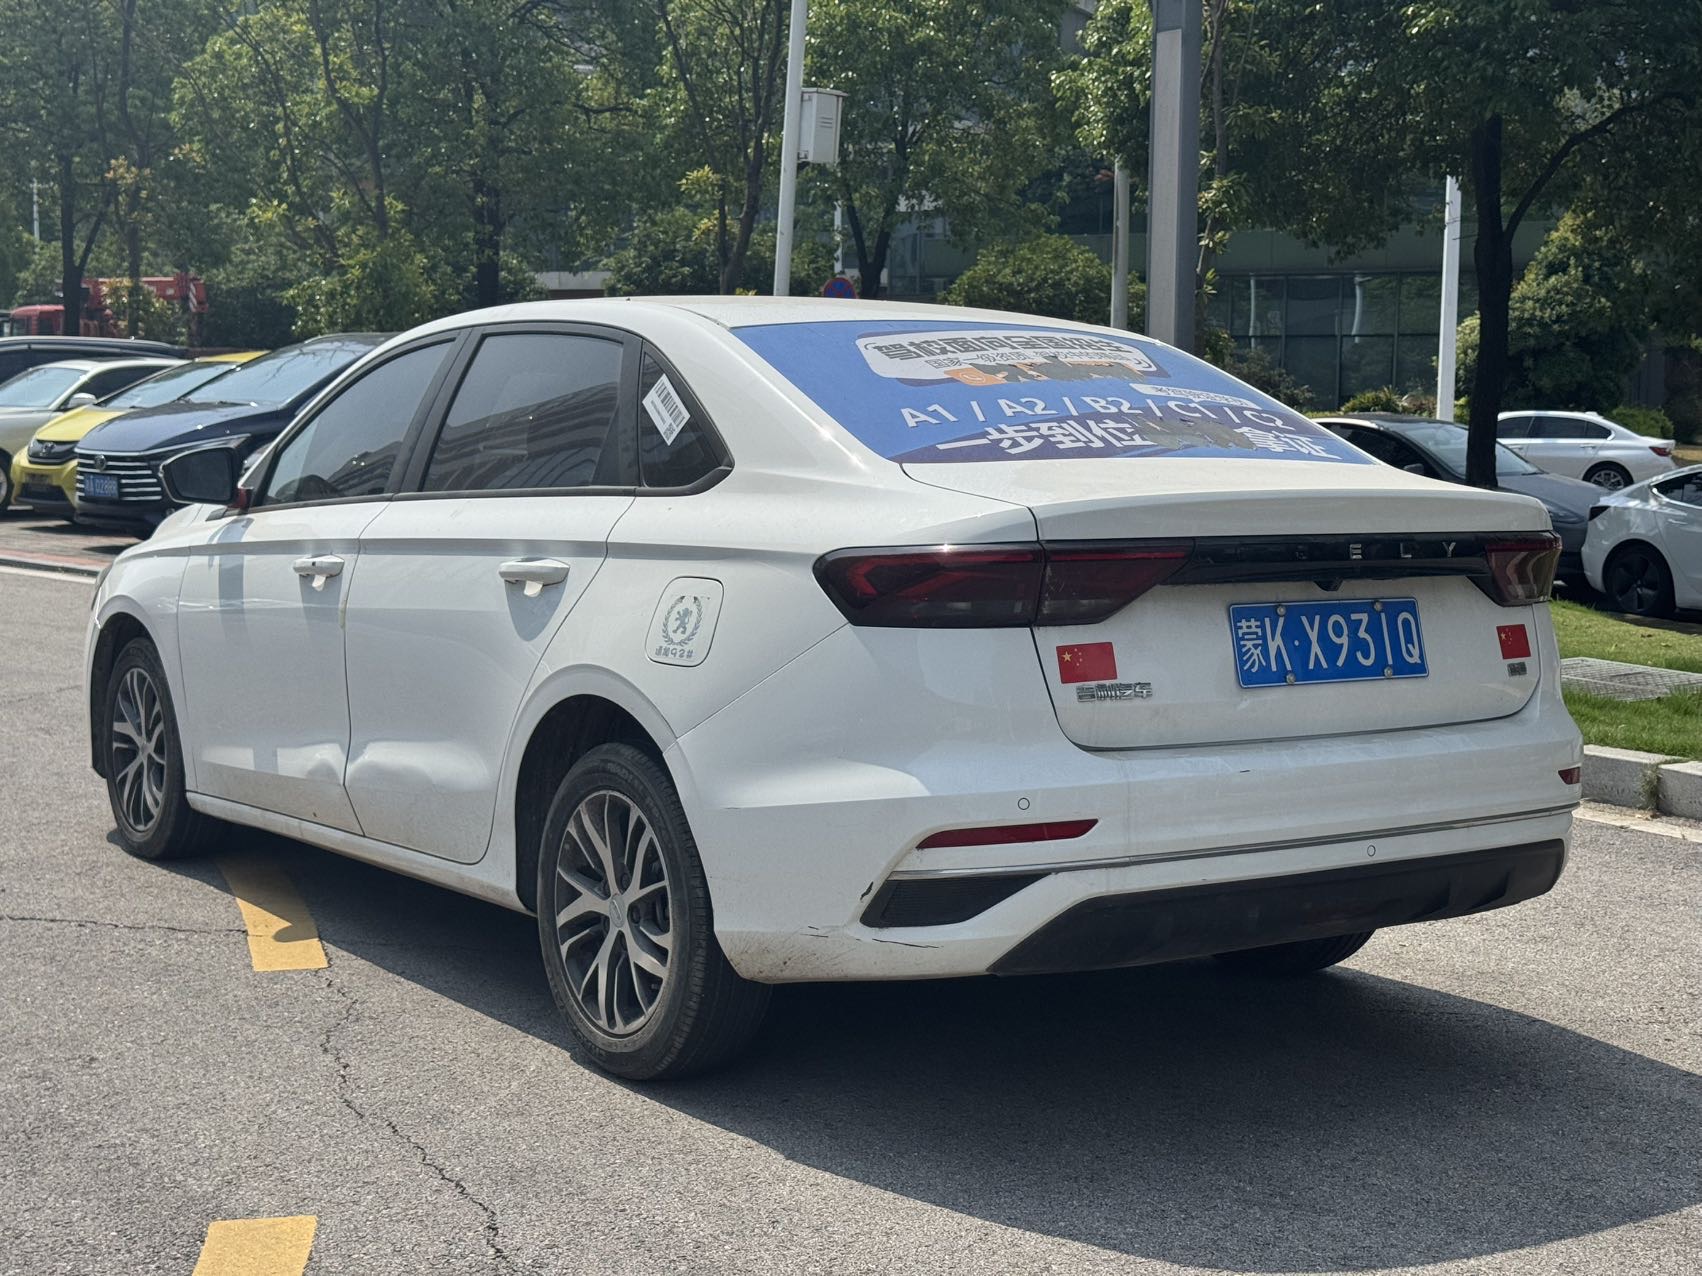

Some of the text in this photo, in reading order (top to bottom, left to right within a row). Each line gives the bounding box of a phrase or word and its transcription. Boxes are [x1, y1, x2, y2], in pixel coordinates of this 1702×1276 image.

[873, 335, 1133, 360] 驾校面向全国招生
[900, 403, 959, 428] A1
[997, 397, 1059, 417] A2
[1080, 396, 1143, 415] B2
[1168, 400, 1219, 419] C1
[1243, 410, 1296, 431] C2
[935, 419, 1343, 460] 一步到位 拿证
